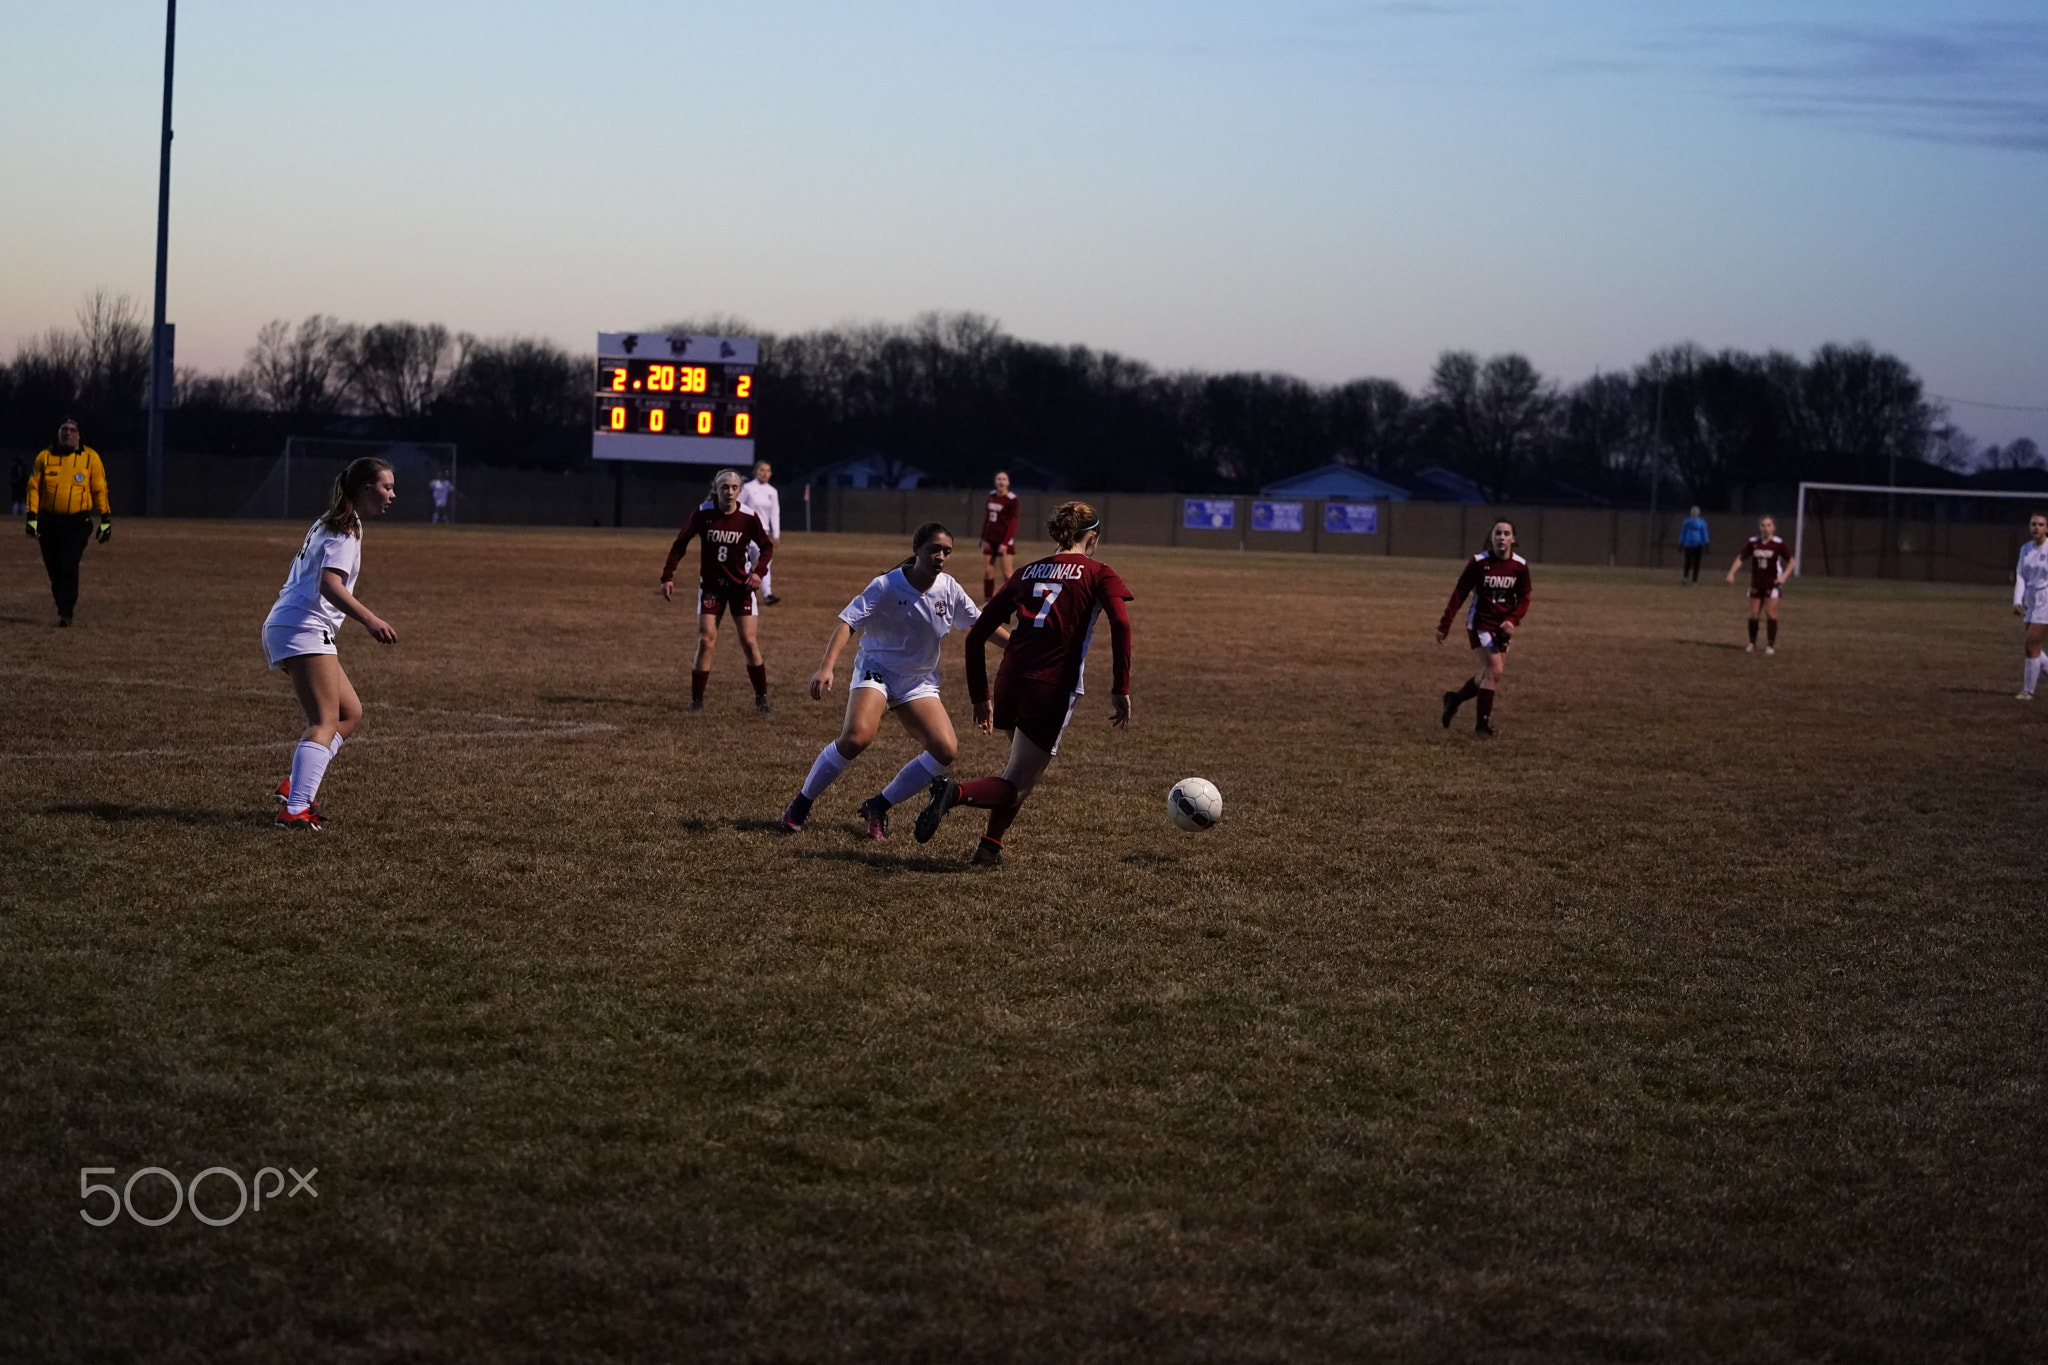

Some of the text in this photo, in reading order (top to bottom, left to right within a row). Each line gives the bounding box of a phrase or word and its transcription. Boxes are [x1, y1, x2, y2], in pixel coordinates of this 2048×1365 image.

[736, 374, 751, 398] 2
[611, 406, 749, 437] 0 0 0 0
[707, 529, 743, 544] FONDY
[717, 546, 728, 562] 8
[1021, 563, 1085, 581] CARDINALS
[1483, 575, 1517, 588] FONDY
[1032, 582, 1063, 628] 7
